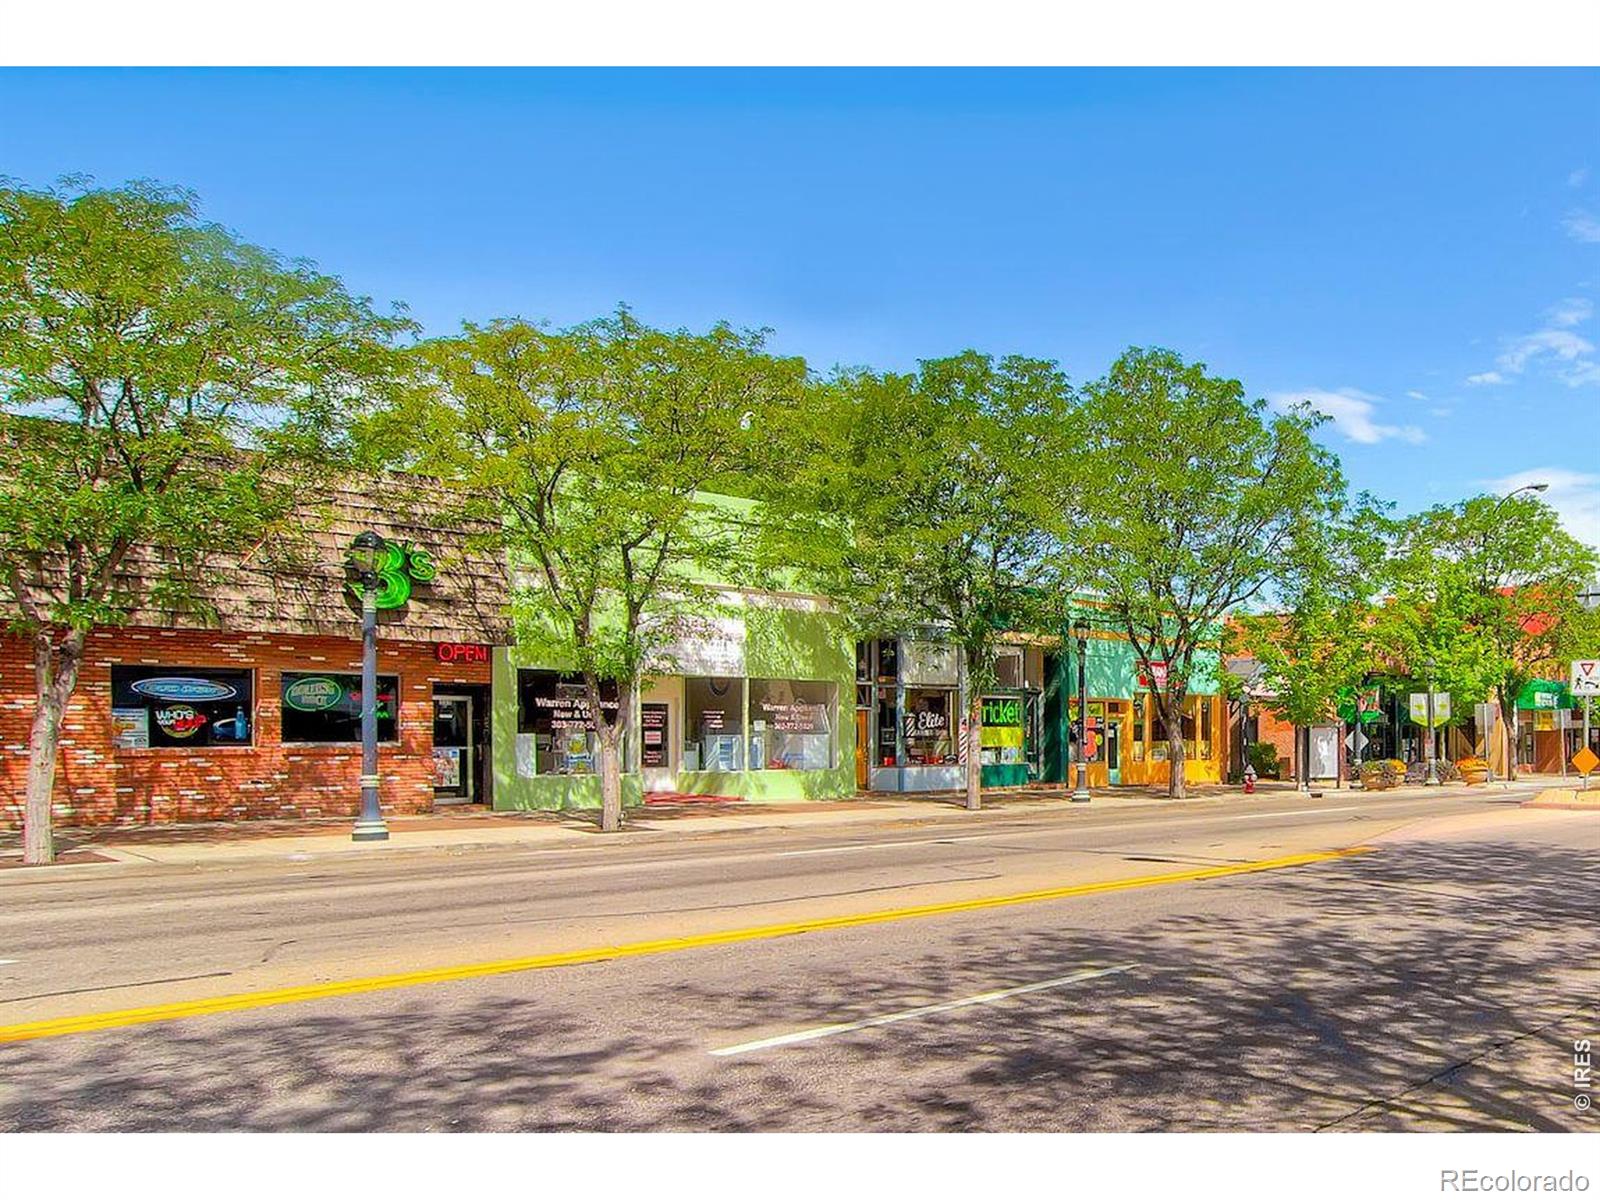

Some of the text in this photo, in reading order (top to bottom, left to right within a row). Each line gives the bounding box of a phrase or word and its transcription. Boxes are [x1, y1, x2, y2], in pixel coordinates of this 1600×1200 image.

[438, 643, 488, 661] OPEN
[535, 697, 572, 708] Warren
[155, 709, 195, 720] WHO'S
[553, 709, 573, 718] New
[982, 700, 1021, 723] ricket
[918, 711, 945, 730] Elite
